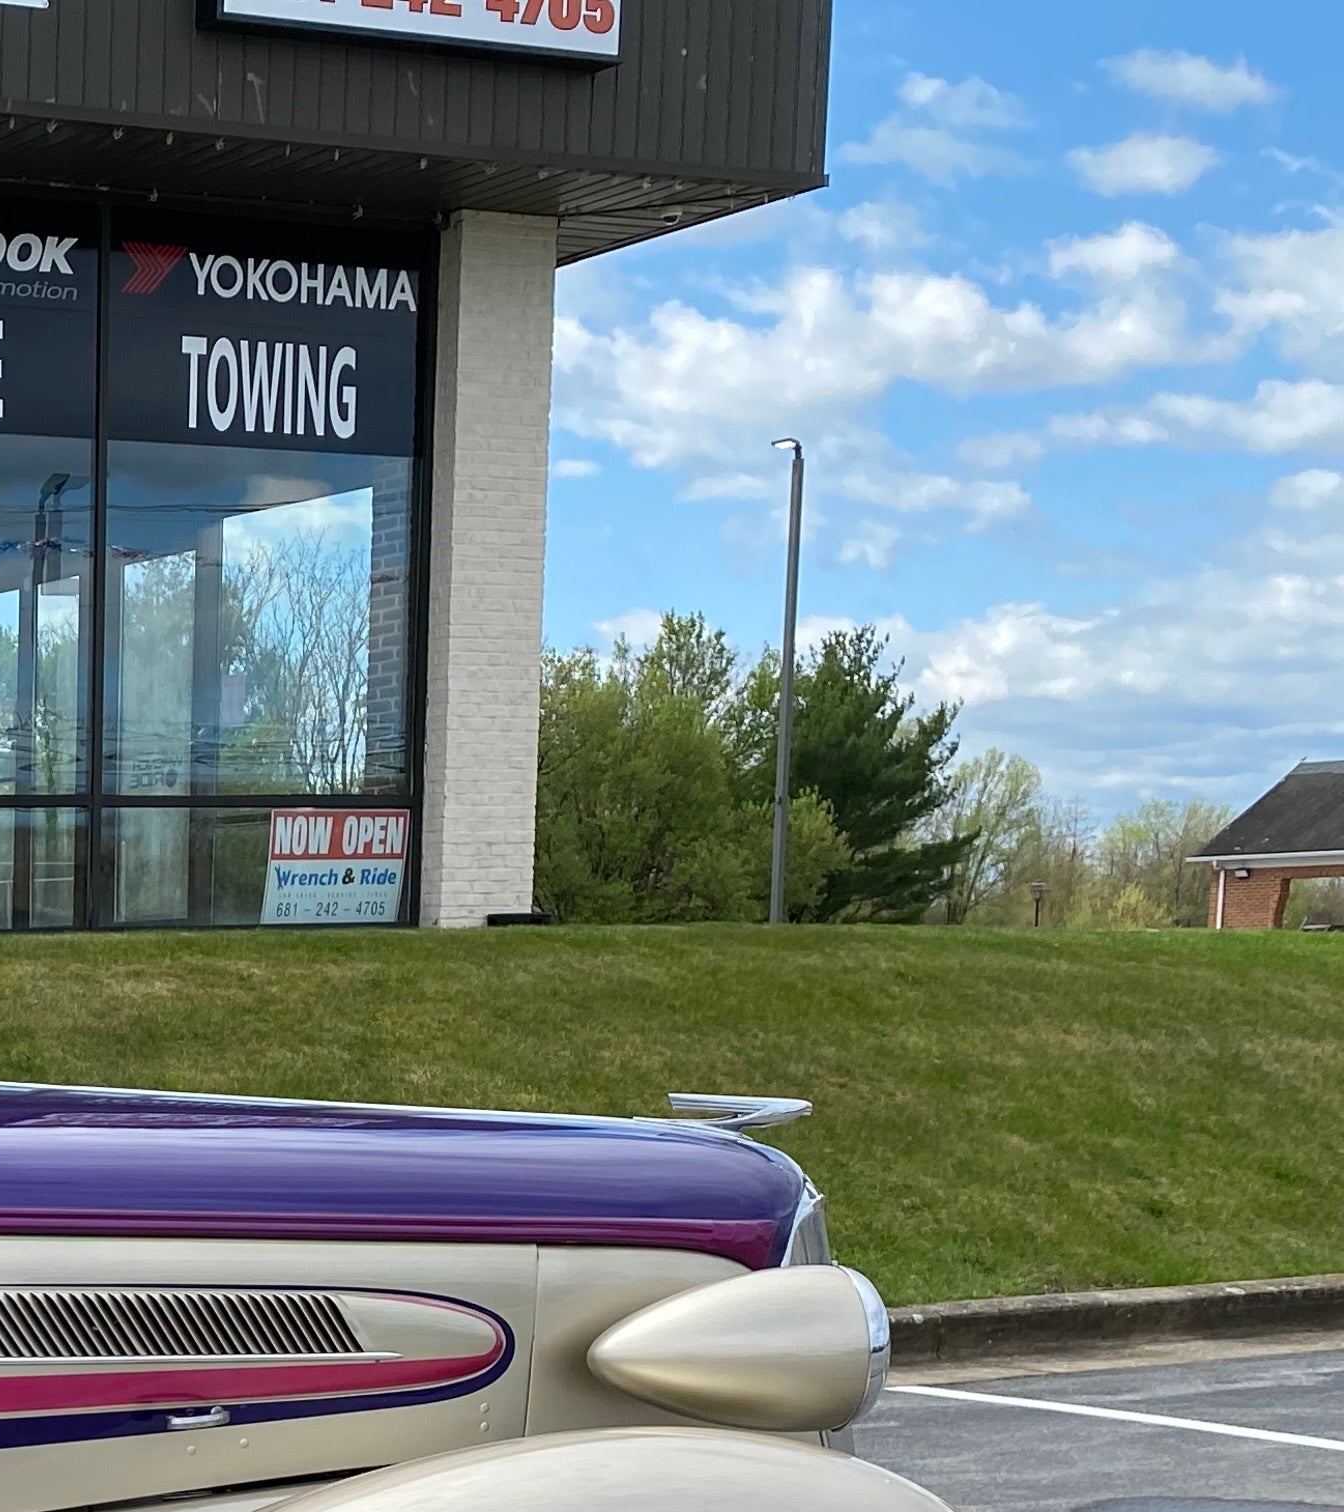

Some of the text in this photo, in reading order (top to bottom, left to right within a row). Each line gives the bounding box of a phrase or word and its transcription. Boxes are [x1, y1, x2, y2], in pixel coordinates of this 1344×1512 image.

[188, 252, 417, 312] YOKOHAMA
[181, 335, 357, 440] TOWING
[274, 815, 404, 855] NOW OPEN
[274, 864, 338, 889] Wrench
[360, 868, 397, 885] Ride
[276, 902, 298, 917] 681
[315, 902, 339, 917] 242
[356, 901, 386, 916] 4705
